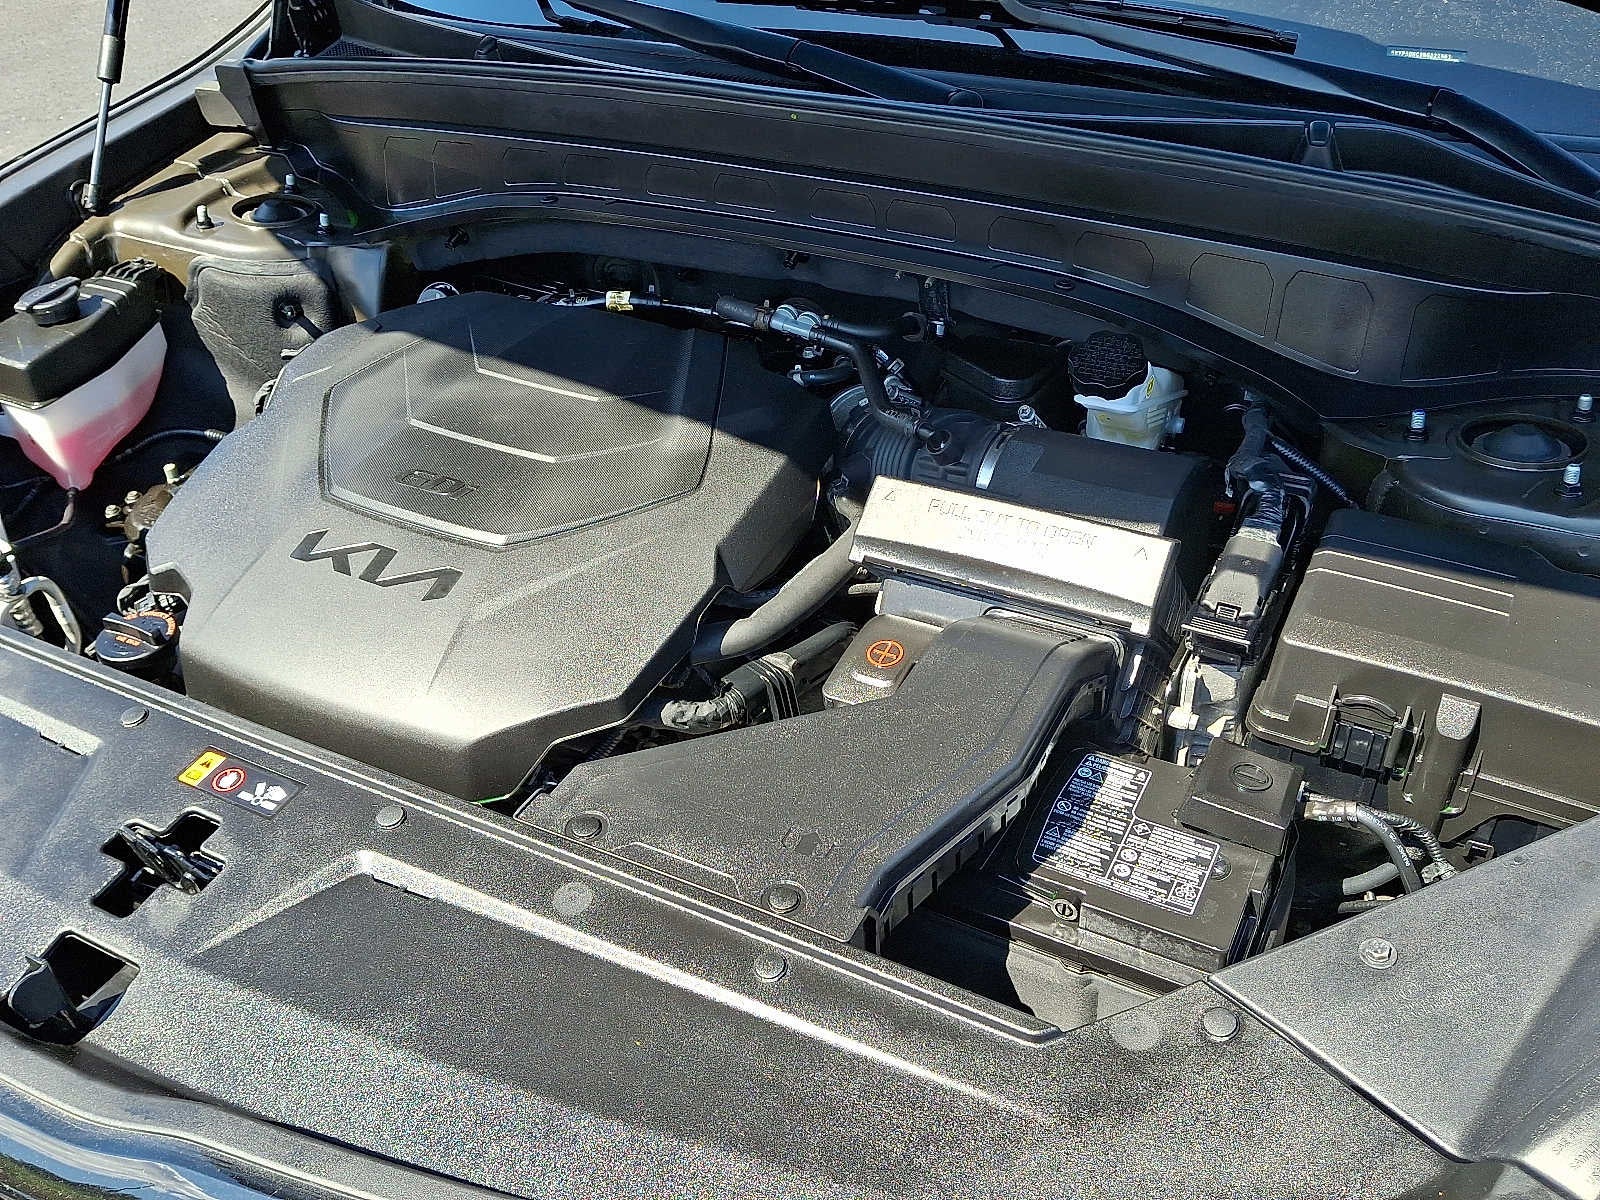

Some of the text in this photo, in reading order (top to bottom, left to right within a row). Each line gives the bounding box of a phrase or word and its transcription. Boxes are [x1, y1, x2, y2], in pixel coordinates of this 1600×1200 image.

[927, 498, 970, 521] PULL
[1016, 516, 1040, 536] TO
[1043, 524, 1097, 549] OPEN
[290, 528, 464, 601] KIA
